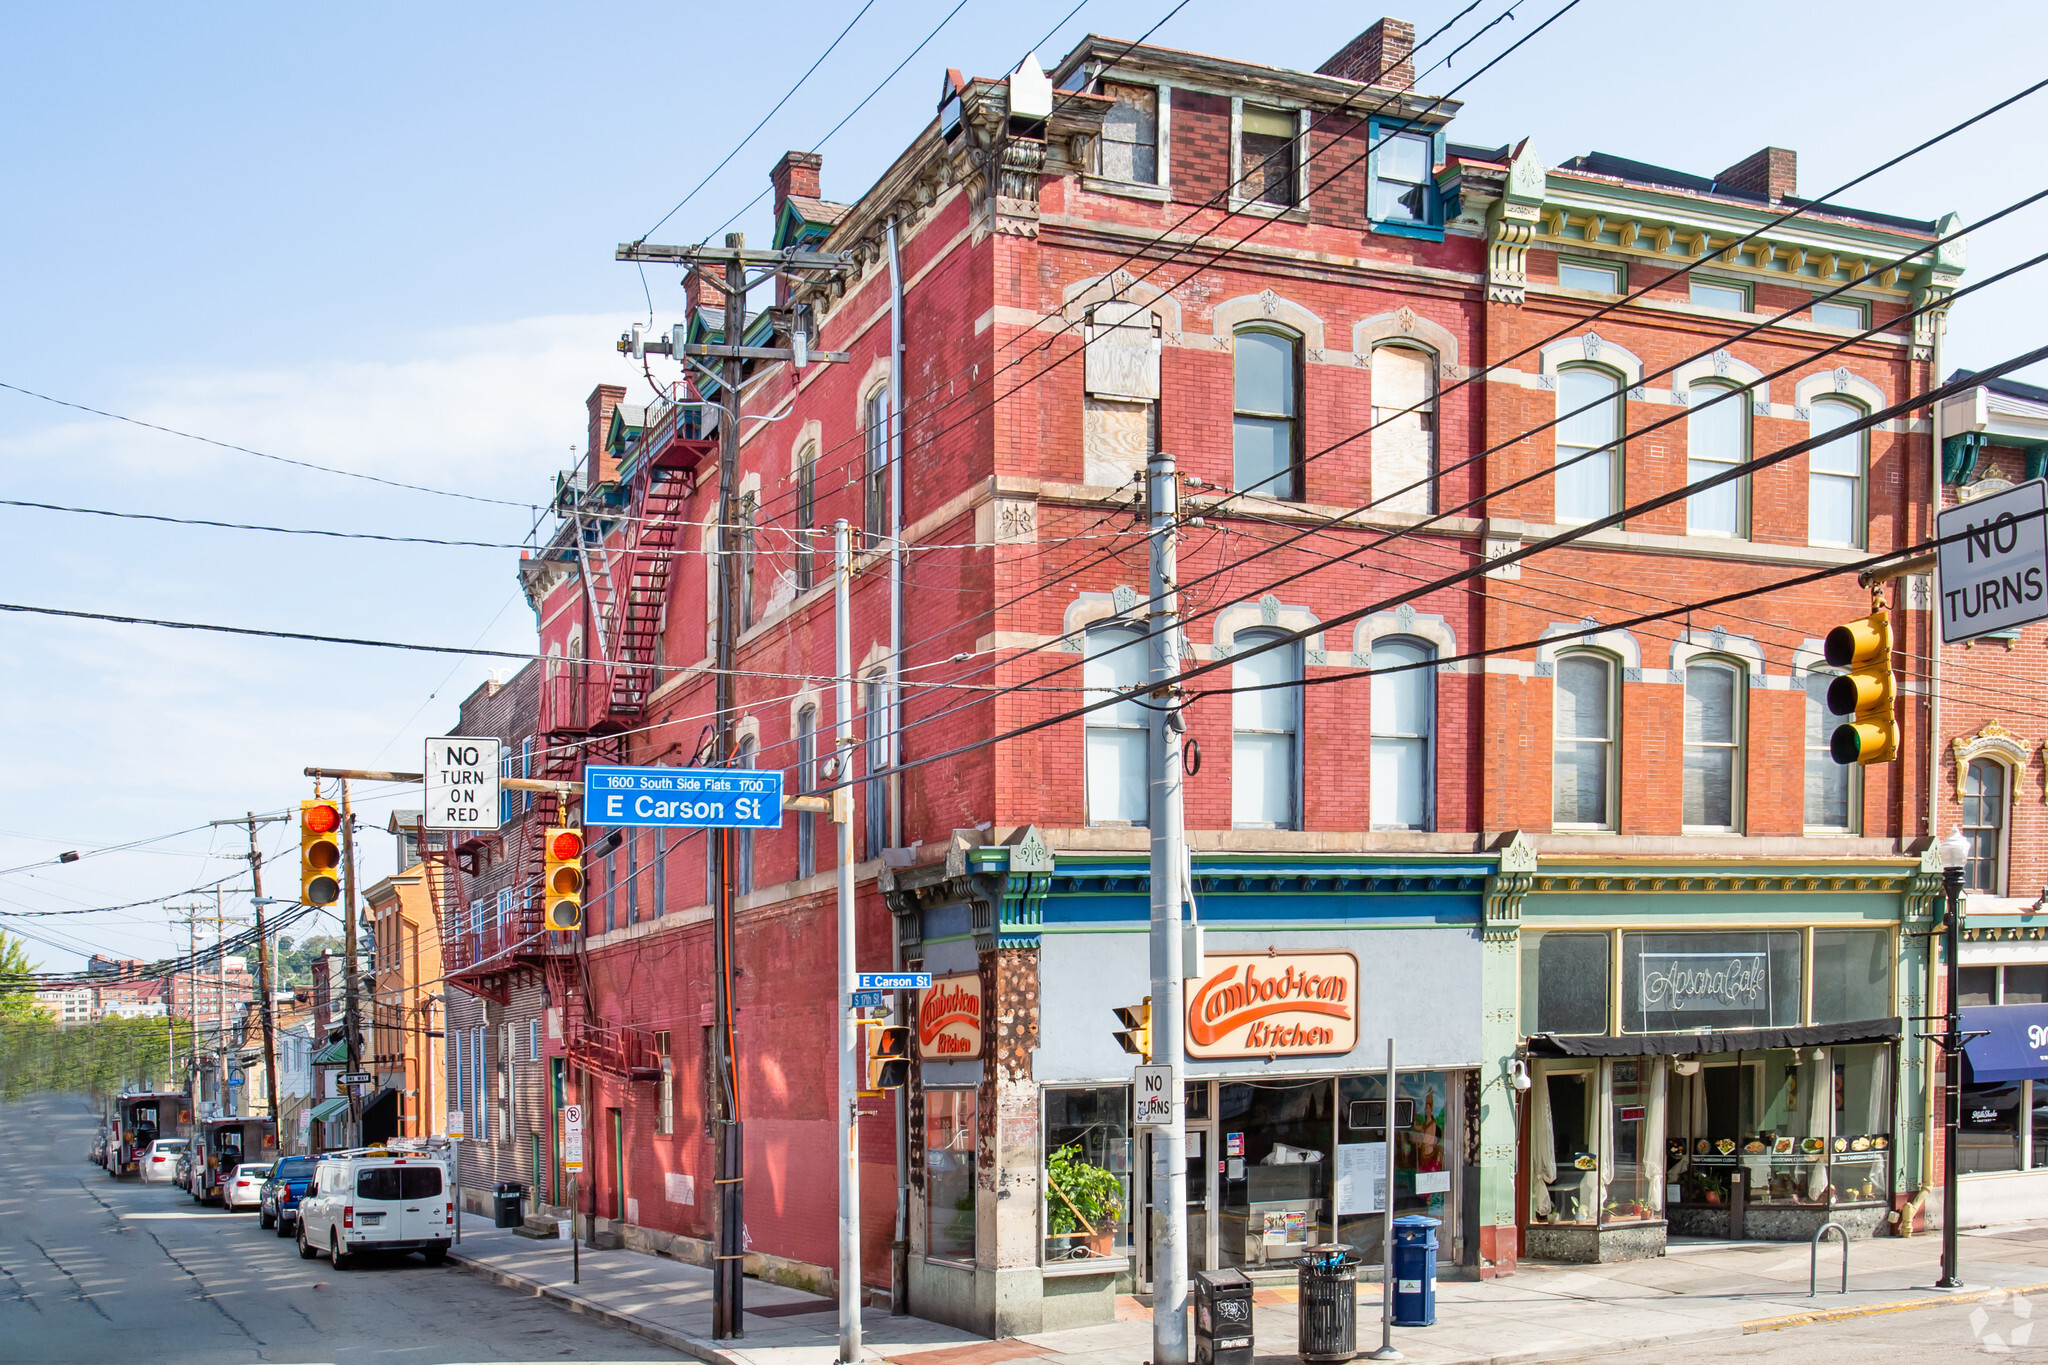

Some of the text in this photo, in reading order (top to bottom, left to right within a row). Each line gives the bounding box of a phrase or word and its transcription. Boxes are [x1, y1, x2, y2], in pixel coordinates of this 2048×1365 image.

[1966, 511, 2018, 564] NO
[1944, 567, 2043, 622] TURNS
[447, 746, 479, 766] NO
[441, 770, 484, 785] TURN
[607, 776, 764, 792] 1600 South Side Flats 1700
[451, 789, 474, 803] ON
[447, 807, 479, 822] RED
[606, 795, 761, 820] E Carson St
[862, 975, 928, 987] E Carson St
[1644, 956, 1766, 1010] Apsara Cafe
[854, 993, 880, 1006] S 17th St
[937, 1032, 971, 1054] Kitchen
[1245, 1021, 1334, 1049] Kitchen
[1145, 1075, 1163, 1092] NO
[1137, 1100, 1170, 1115] TURNS
